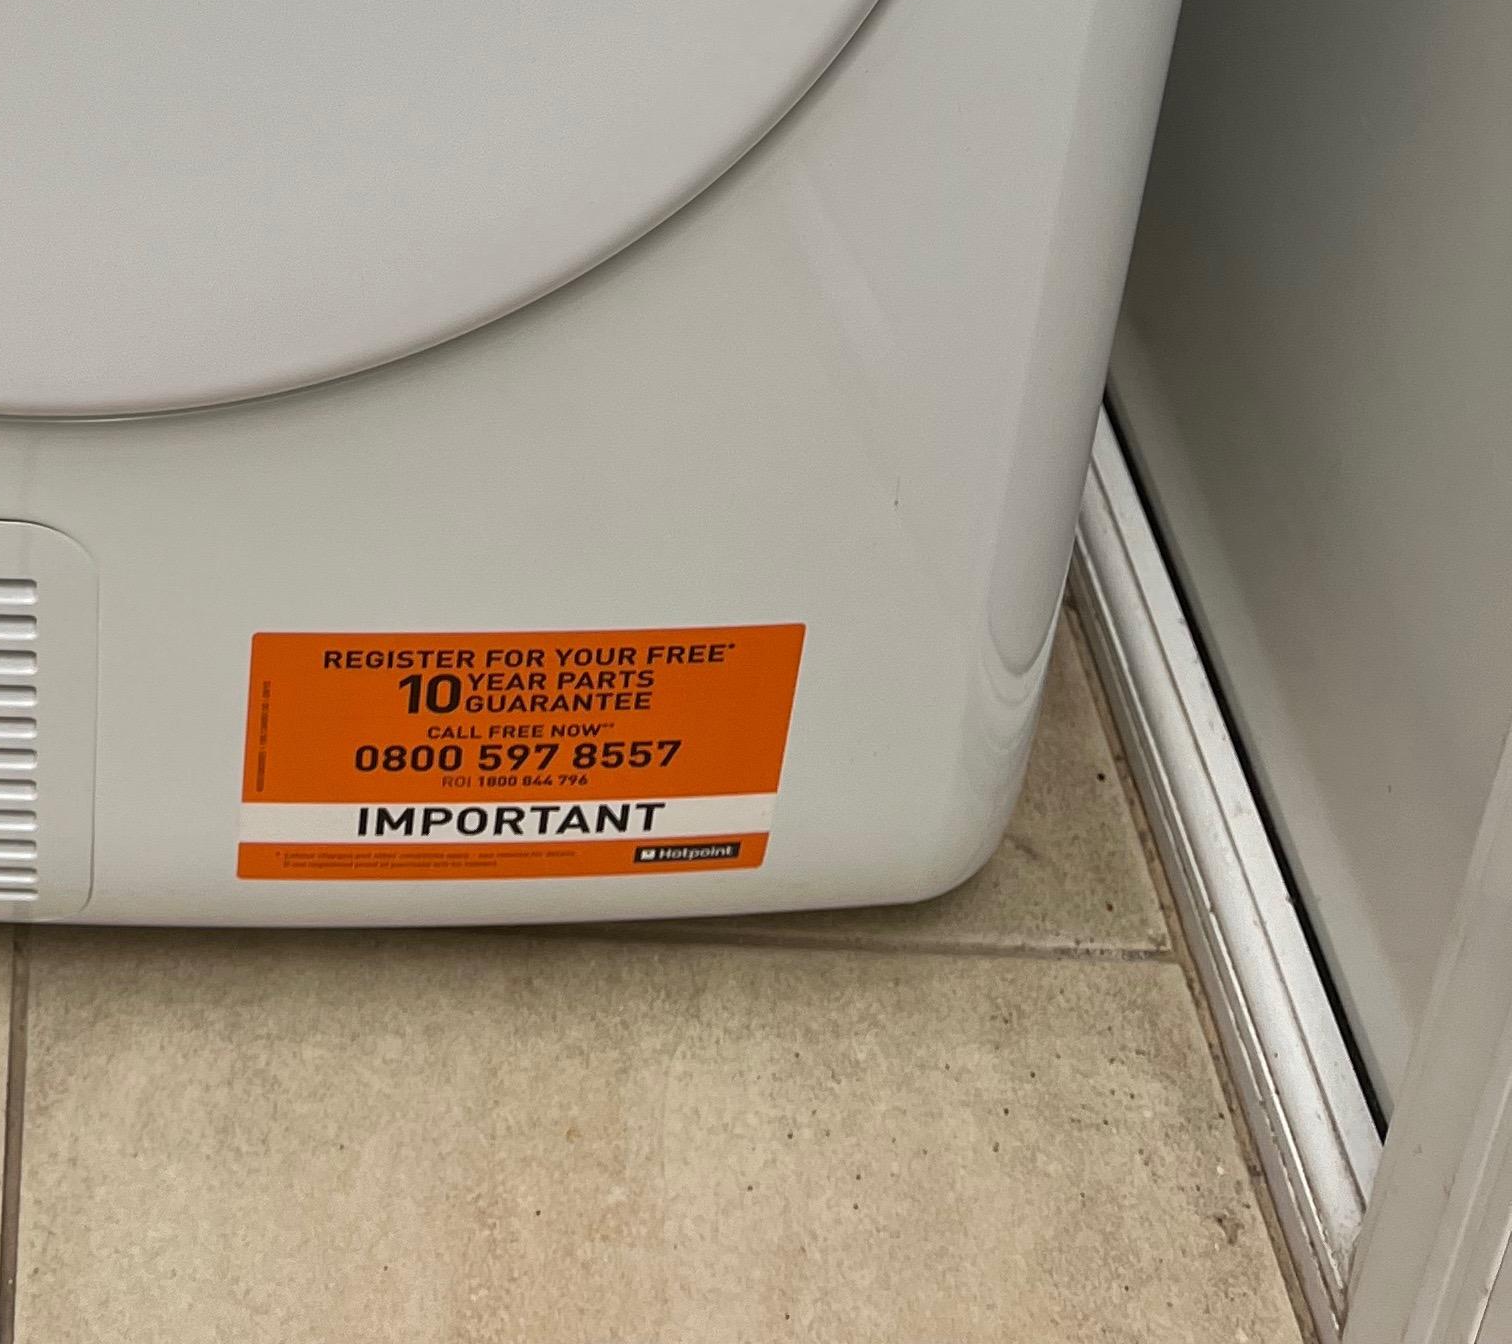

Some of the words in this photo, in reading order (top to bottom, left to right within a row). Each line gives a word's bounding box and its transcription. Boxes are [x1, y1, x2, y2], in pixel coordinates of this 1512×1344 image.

[324, 650, 475, 670] REGISTER
[487, 649, 545, 668] FOR
[556, 647, 637, 667] YOUR
[398, 673, 462, 715] 10
[469, 672, 547, 691] YEAR
[557, 670, 655, 690] PARTS
[465, 691, 652, 713] GUARANTEE
[428, 725, 482, 739] CALL
[489, 725, 544, 738] FREE
[355, 744, 463, 772] 0800
[478, 743, 560, 771] 597
[572, 740, 682, 768] 8557
[558, 774, 587, 785] 796
[356, 802, 666, 837] IMPORTANT
[659, 846, 733, 860] Hotpoint
